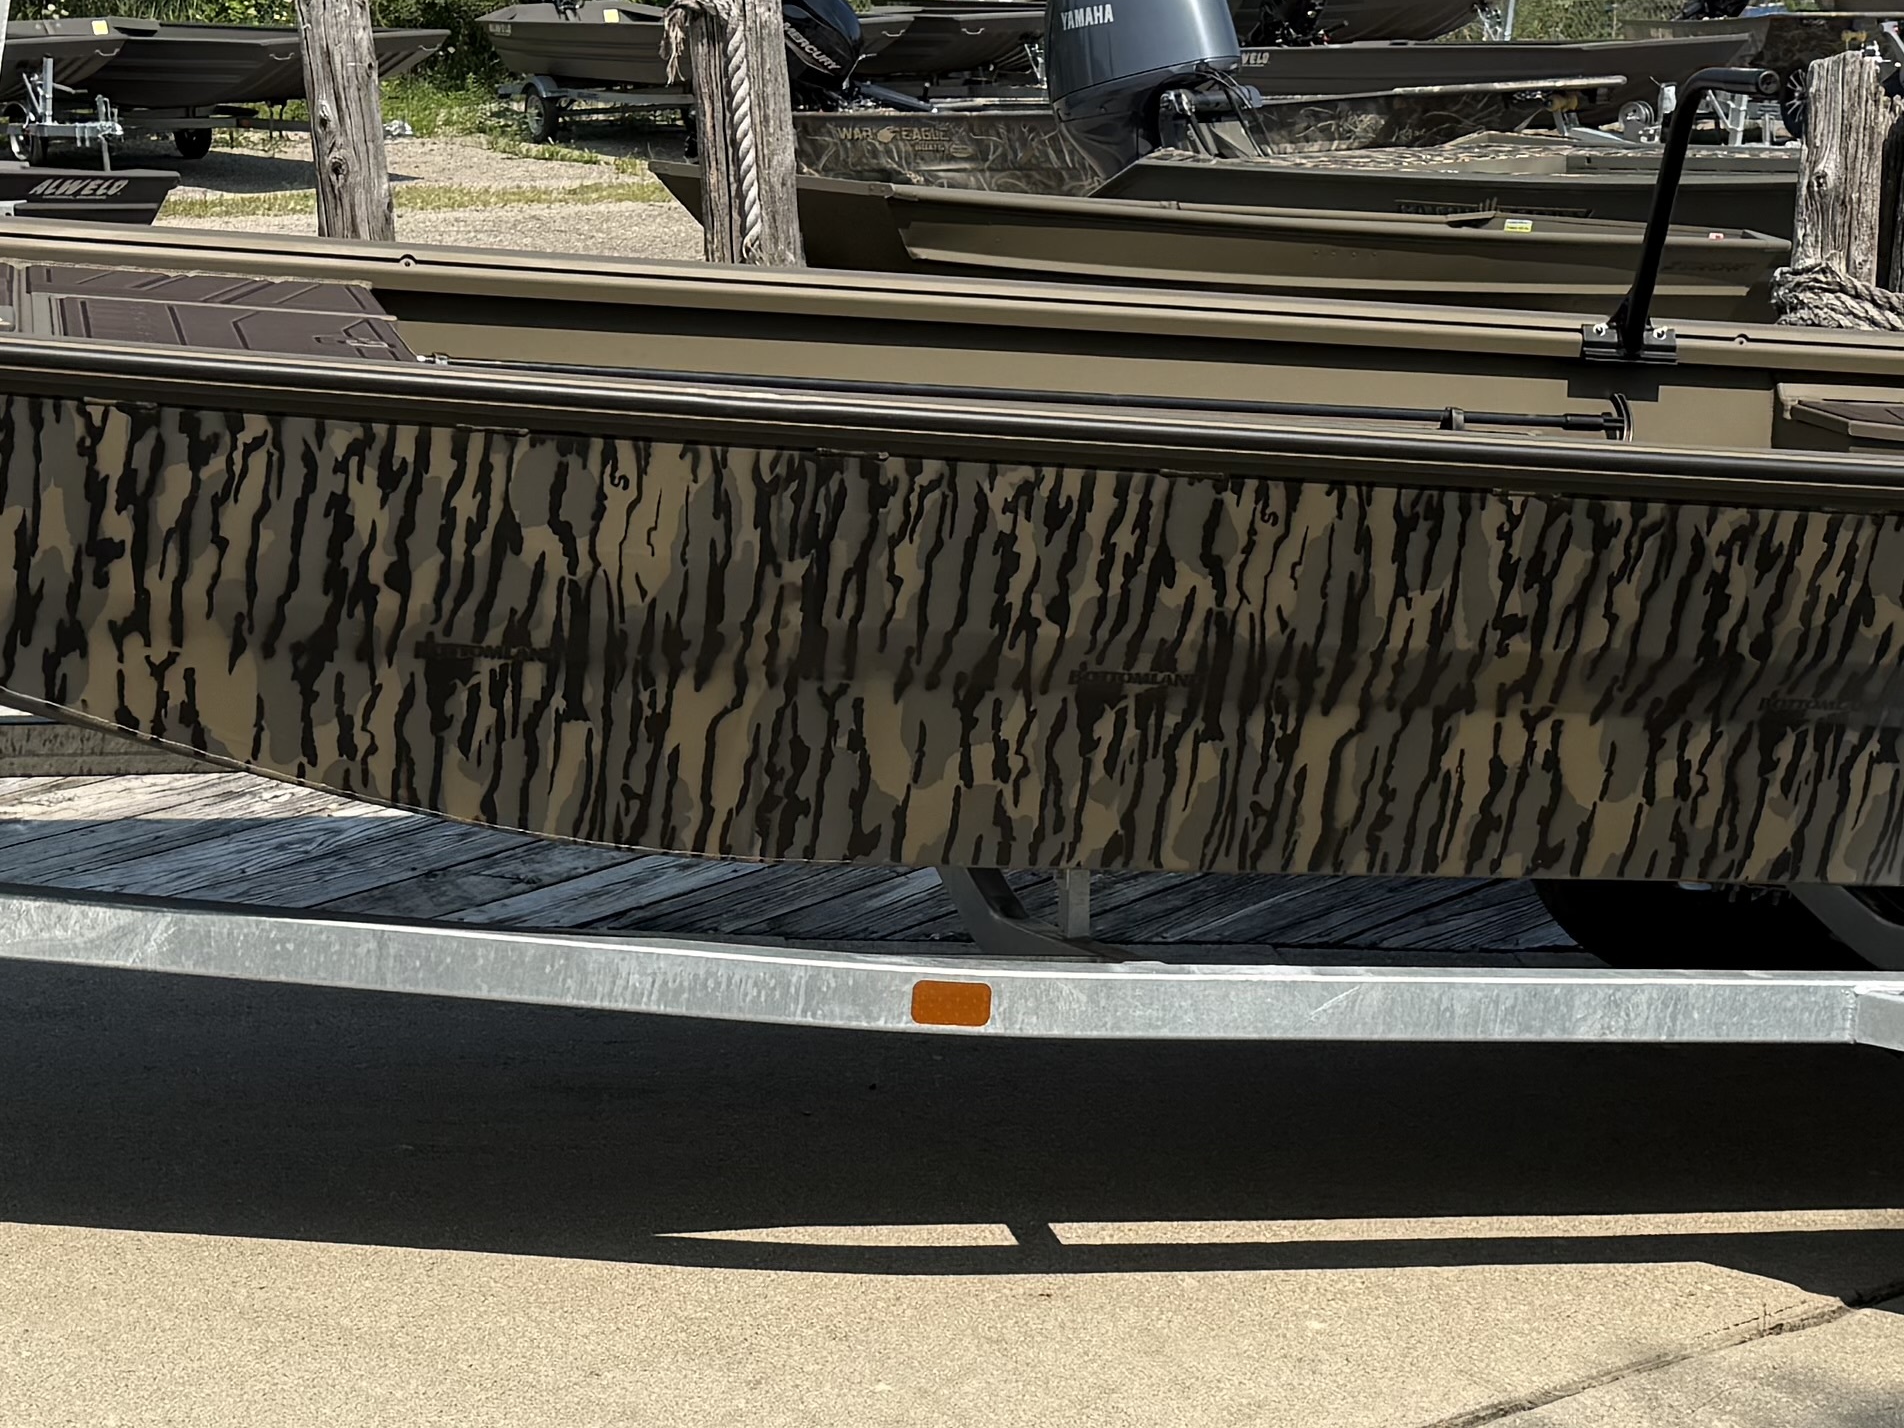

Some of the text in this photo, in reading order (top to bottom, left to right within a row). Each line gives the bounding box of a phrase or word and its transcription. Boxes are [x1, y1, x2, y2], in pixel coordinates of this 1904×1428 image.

[1060, 3, 1114, 31] YAMAHA
[837, 126, 950, 141] WAR EAGLE
[28, 178, 129, 196] ALWELD
